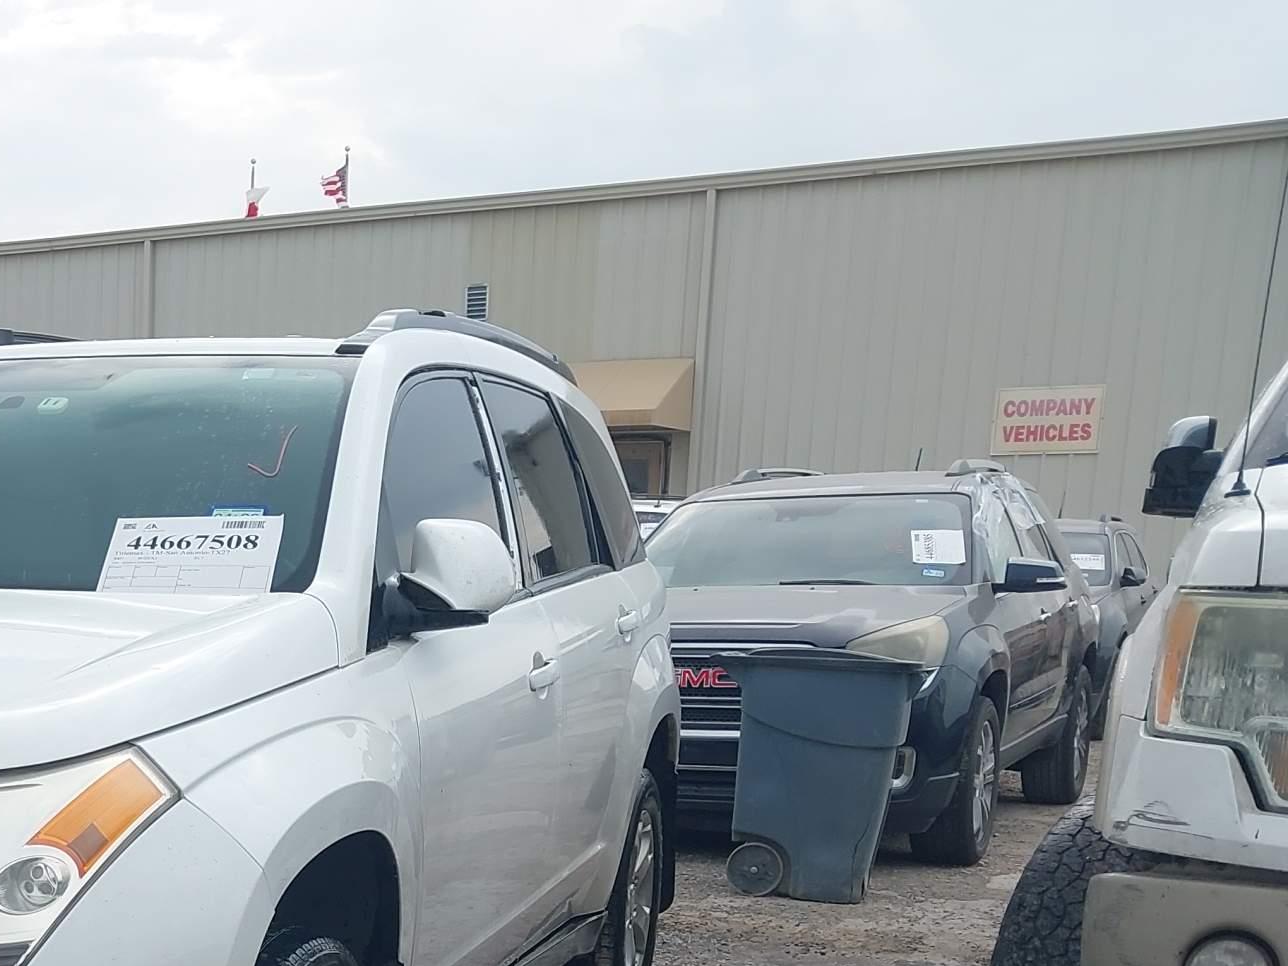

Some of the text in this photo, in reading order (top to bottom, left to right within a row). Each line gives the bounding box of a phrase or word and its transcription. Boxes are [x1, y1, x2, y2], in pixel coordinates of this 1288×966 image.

[1003, 398, 1096, 418] COMPANY
[1002, 423, 1092, 443] VEHICLES
[127, 535, 259, 550] 44667508
